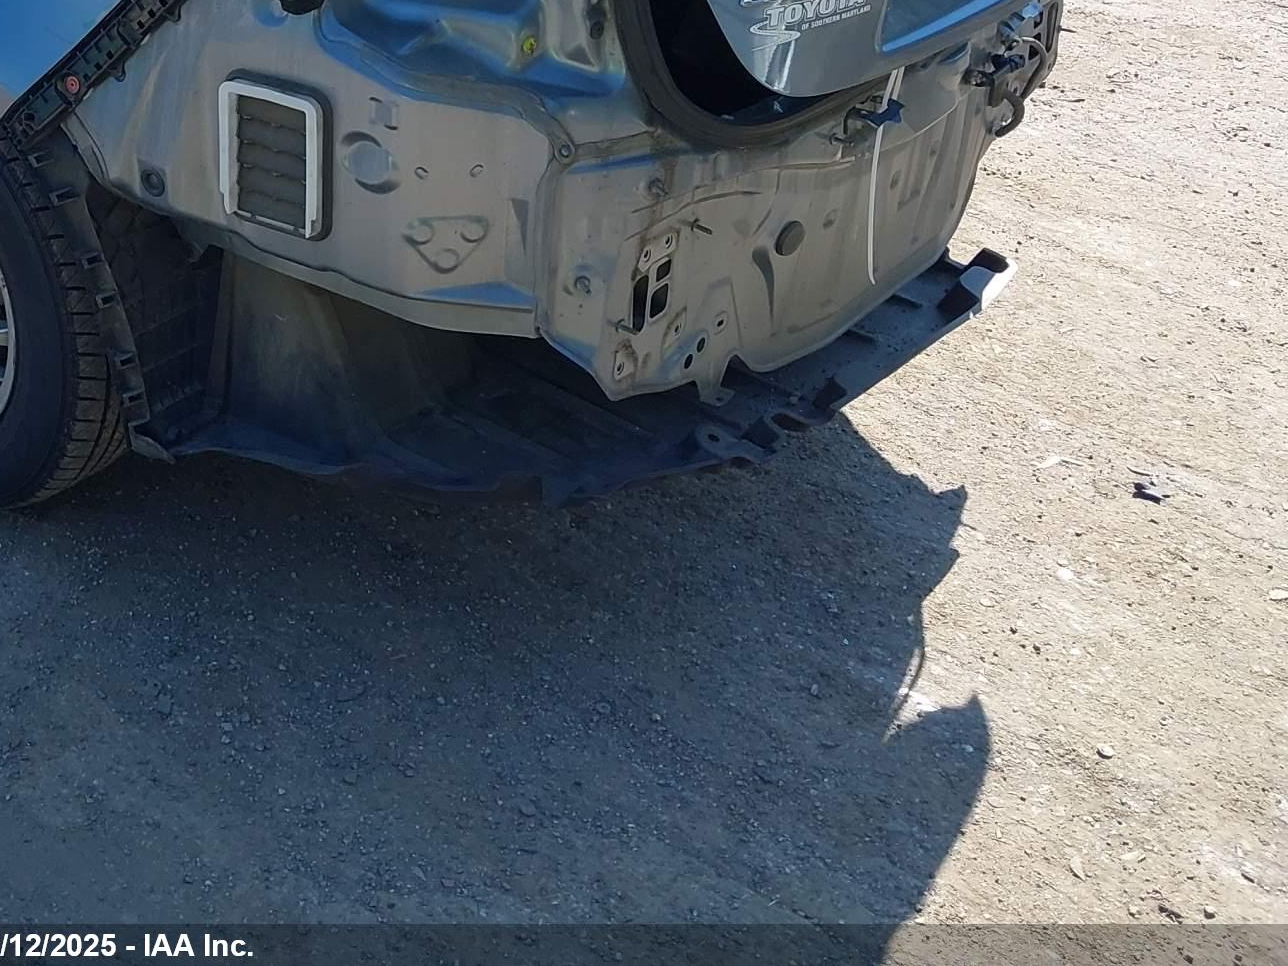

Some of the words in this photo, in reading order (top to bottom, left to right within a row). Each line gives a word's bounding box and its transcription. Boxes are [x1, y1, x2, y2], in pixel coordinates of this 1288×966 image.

[801, 23, 809, 31] OF
[810, 14, 841, 28] SOUTHERN
[841, 4, 872, 20] MARYLAND
